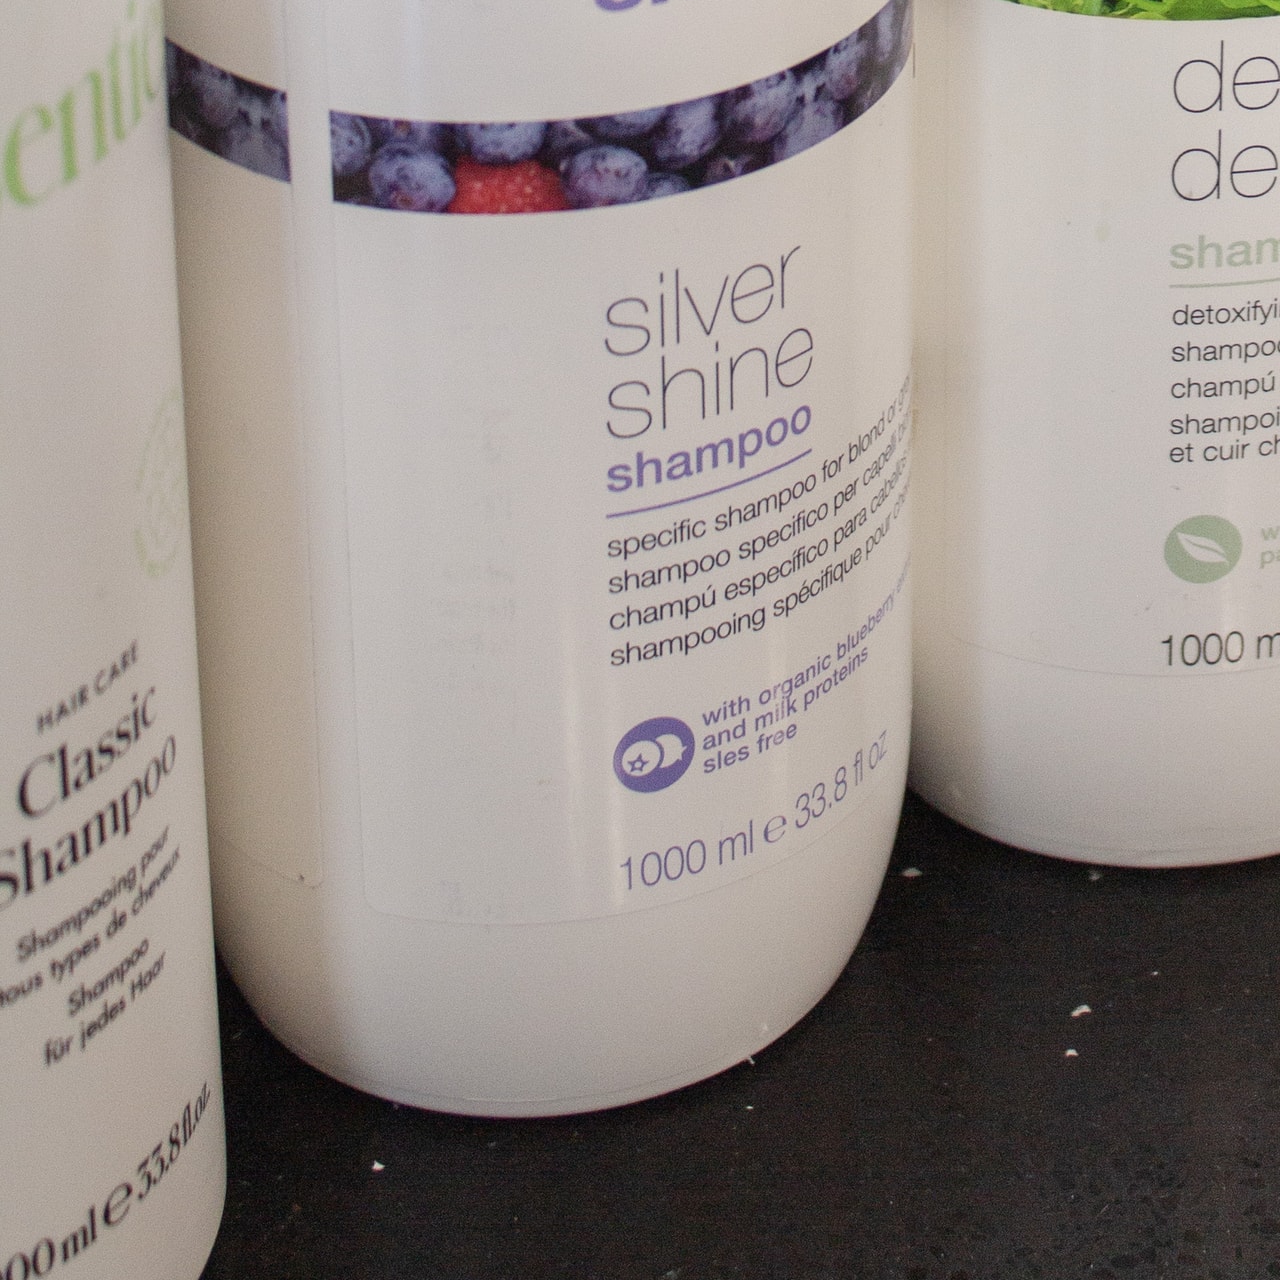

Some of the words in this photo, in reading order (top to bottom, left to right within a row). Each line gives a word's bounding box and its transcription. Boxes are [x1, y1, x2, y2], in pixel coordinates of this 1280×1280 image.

[605, 245, 802, 357] silver
[606, 328, 814, 439] shine
[1170, 370, 1276, 399] champú
[606, 404, 813, 493] shampoo
[607, 518, 707, 560] specific
[714, 473, 817, 531] shampoo
[821, 451, 845, 483] for
[848, 410, 886, 464] blond
[1169, 443, 1194, 463] et
[1203, 440, 1250, 462] cuir
[608, 548, 731, 594] shampoo
[738, 502, 828, 561] specifico
[833, 478, 860, 517] per
[609, 584, 717, 631] champú
[723, 537, 828, 601] específico
[833, 505, 867, 554] para
[610, 607, 766, 667] shampooing
[772, 546, 863, 617] spécifique
[1161, 631, 1244, 666] 1000
[37, 683, 89, 736] HAIR
[702, 696, 750, 727] with
[758, 654, 832, 706] organic
[702, 718, 747, 751] and
[754, 695, 798, 732] milk
[803, 646, 869, 712] proteins
[17, 685, 157, 821] Classic
[703, 745, 750, 774] sles
[757, 722, 798, 754] free
[620, 840, 707, 891] 1000
[717, 820, 754, 866] ml
[795, 766, 848, 829] 33.8
[853, 747, 864, 786] fl
[868, 728, 888, 770] oz
[17, 866, 138, 963] Shampooing
[51, 932, 101, 984] types
[106, 907, 128, 940] de
[68, 937, 150, 1018] Shampoo
[80, 994, 127, 1052] jedes
[61, 1203, 98, 1264] ml
